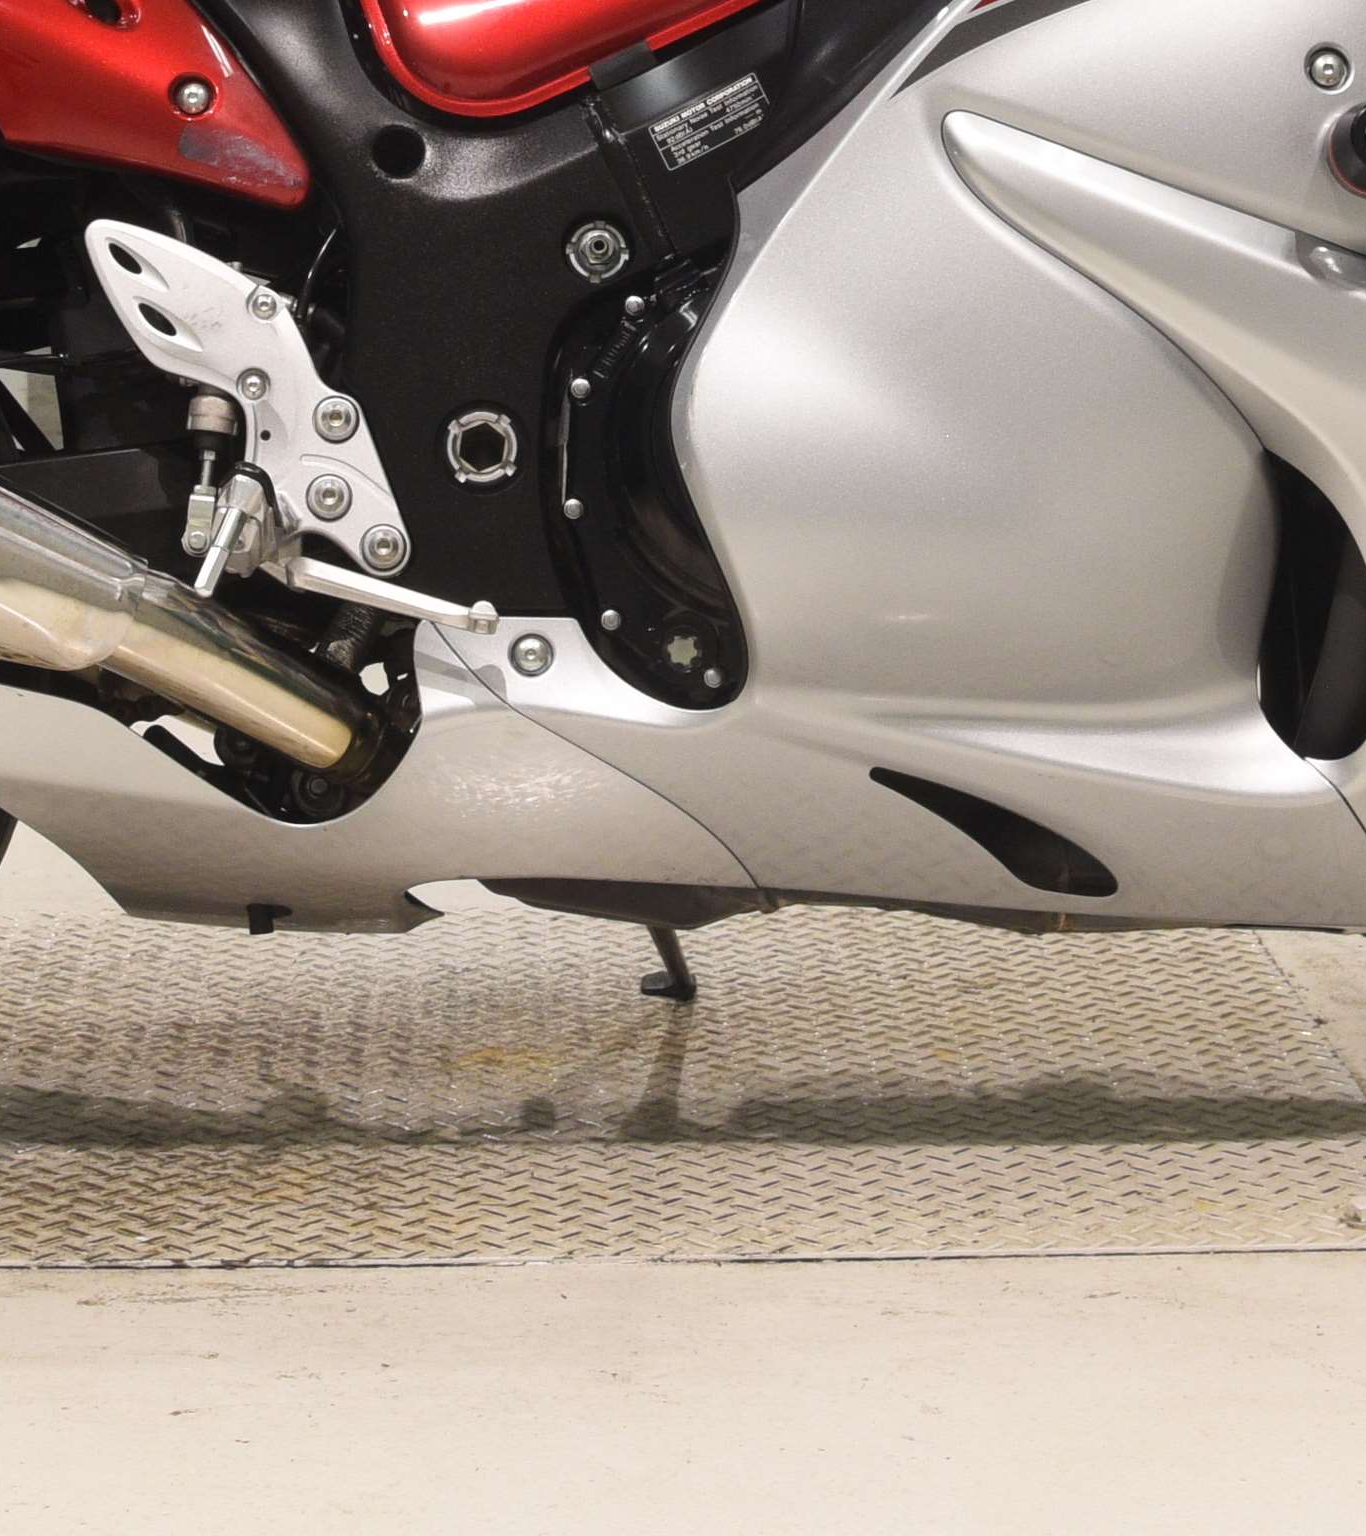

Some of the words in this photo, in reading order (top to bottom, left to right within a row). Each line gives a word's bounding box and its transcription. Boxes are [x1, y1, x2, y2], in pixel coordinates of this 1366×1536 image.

[653, 115, 680, 133] SUZUKI
[680, 102, 706, 119] MOTOR
[706, 77, 754, 105] CORPORATION
